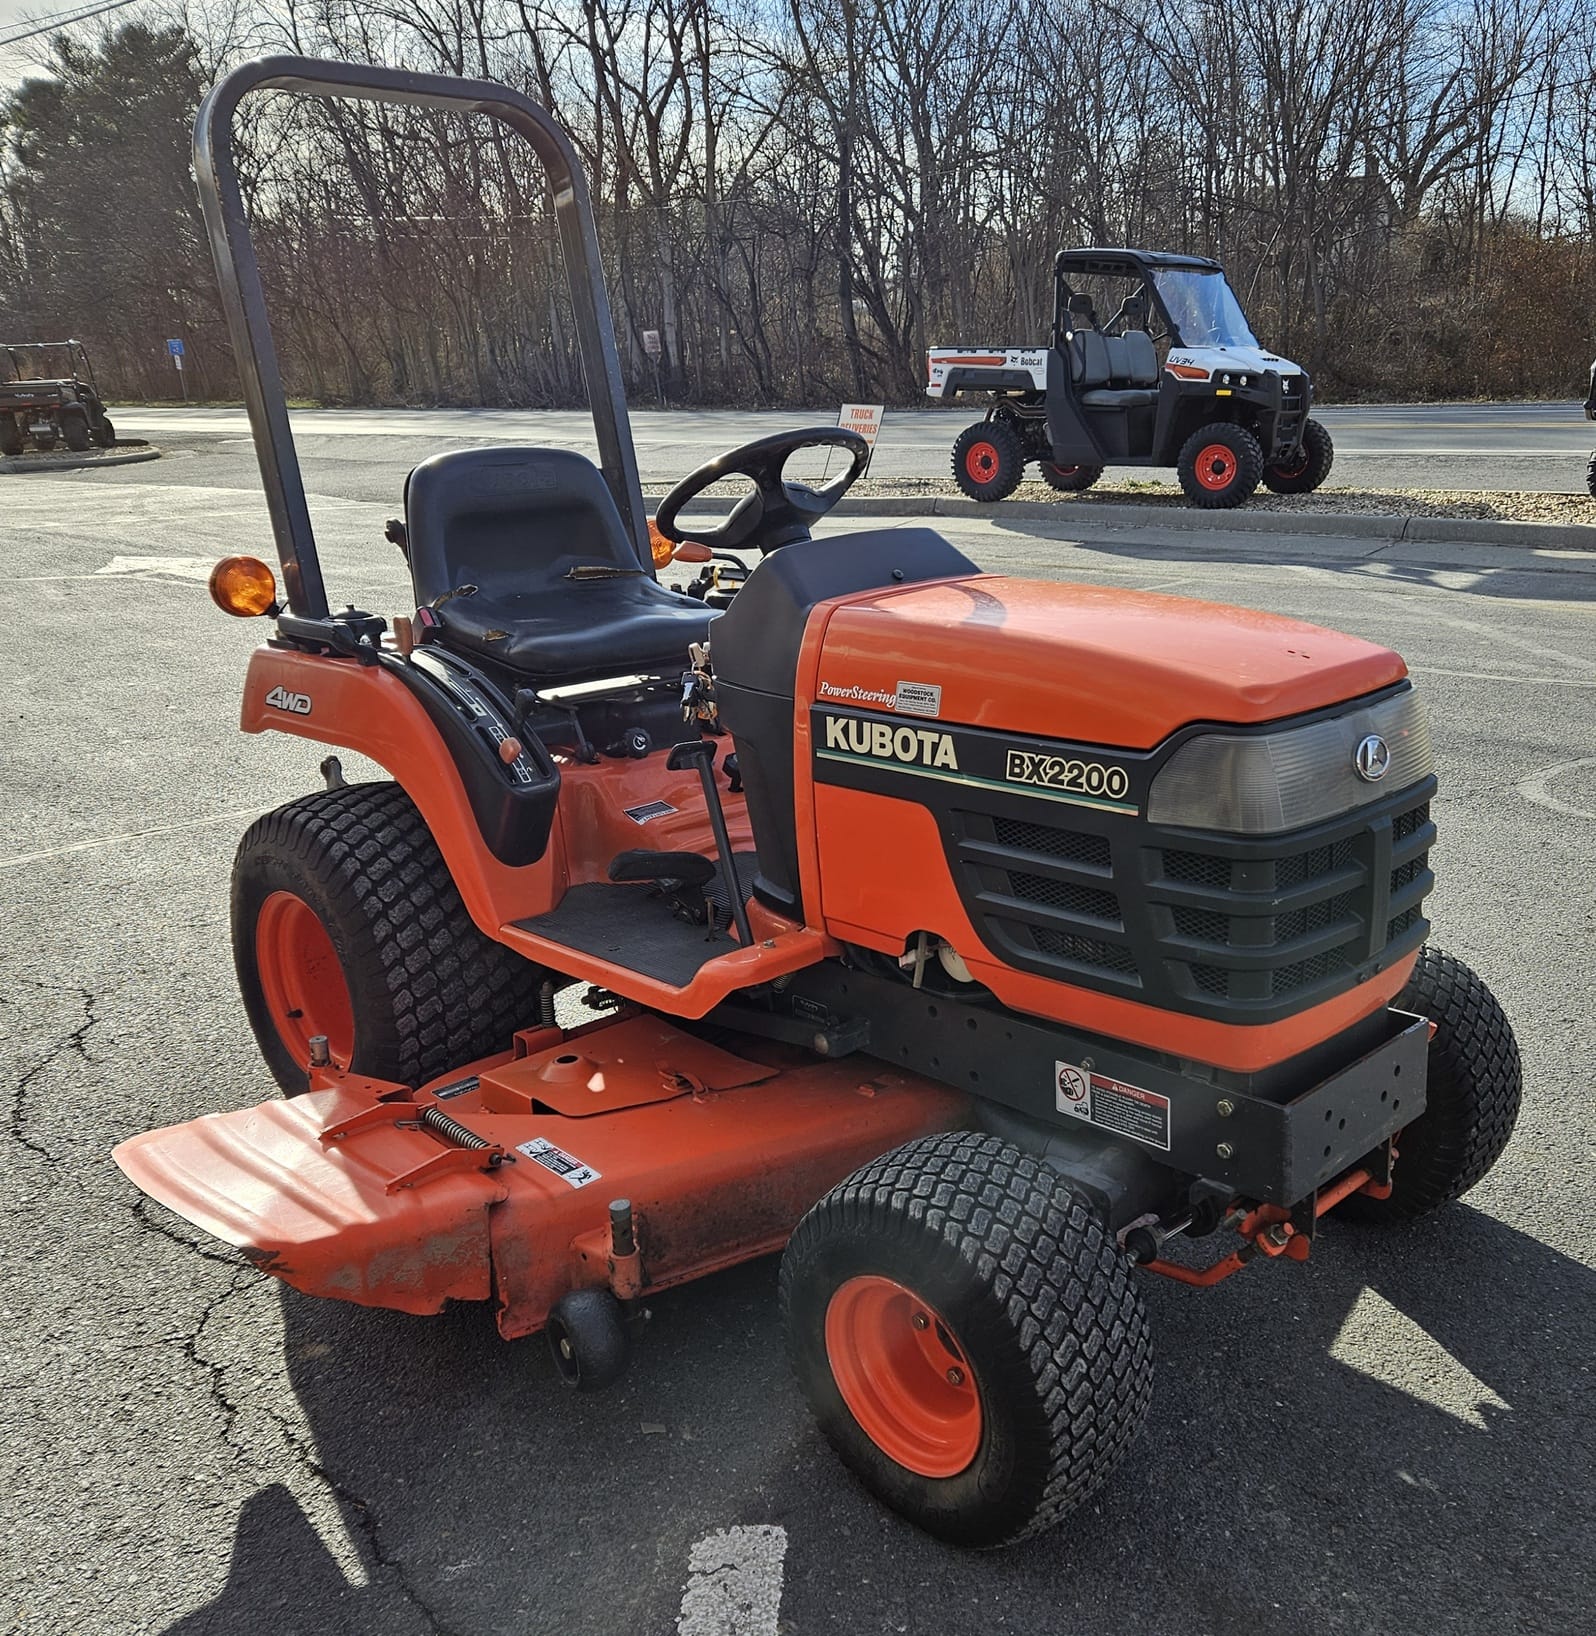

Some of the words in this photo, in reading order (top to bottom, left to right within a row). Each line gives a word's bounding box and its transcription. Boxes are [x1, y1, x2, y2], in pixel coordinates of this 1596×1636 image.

[1021, 357, 1042, 366] Bobcat
[1169, 356, 1195, 365] UV34
[851, 408, 874, 419] TRUCK
[899, 693, 927, 702] EQUIPMENT
[903, 688, 934, 697] WOODSTOCK
[265, 685, 312, 715] 4WD
[826, 716, 958, 770] KUBOTA
[1006, 750, 1129, 799] BX2200
[1118, 1085, 1145, 1100] DANGER
